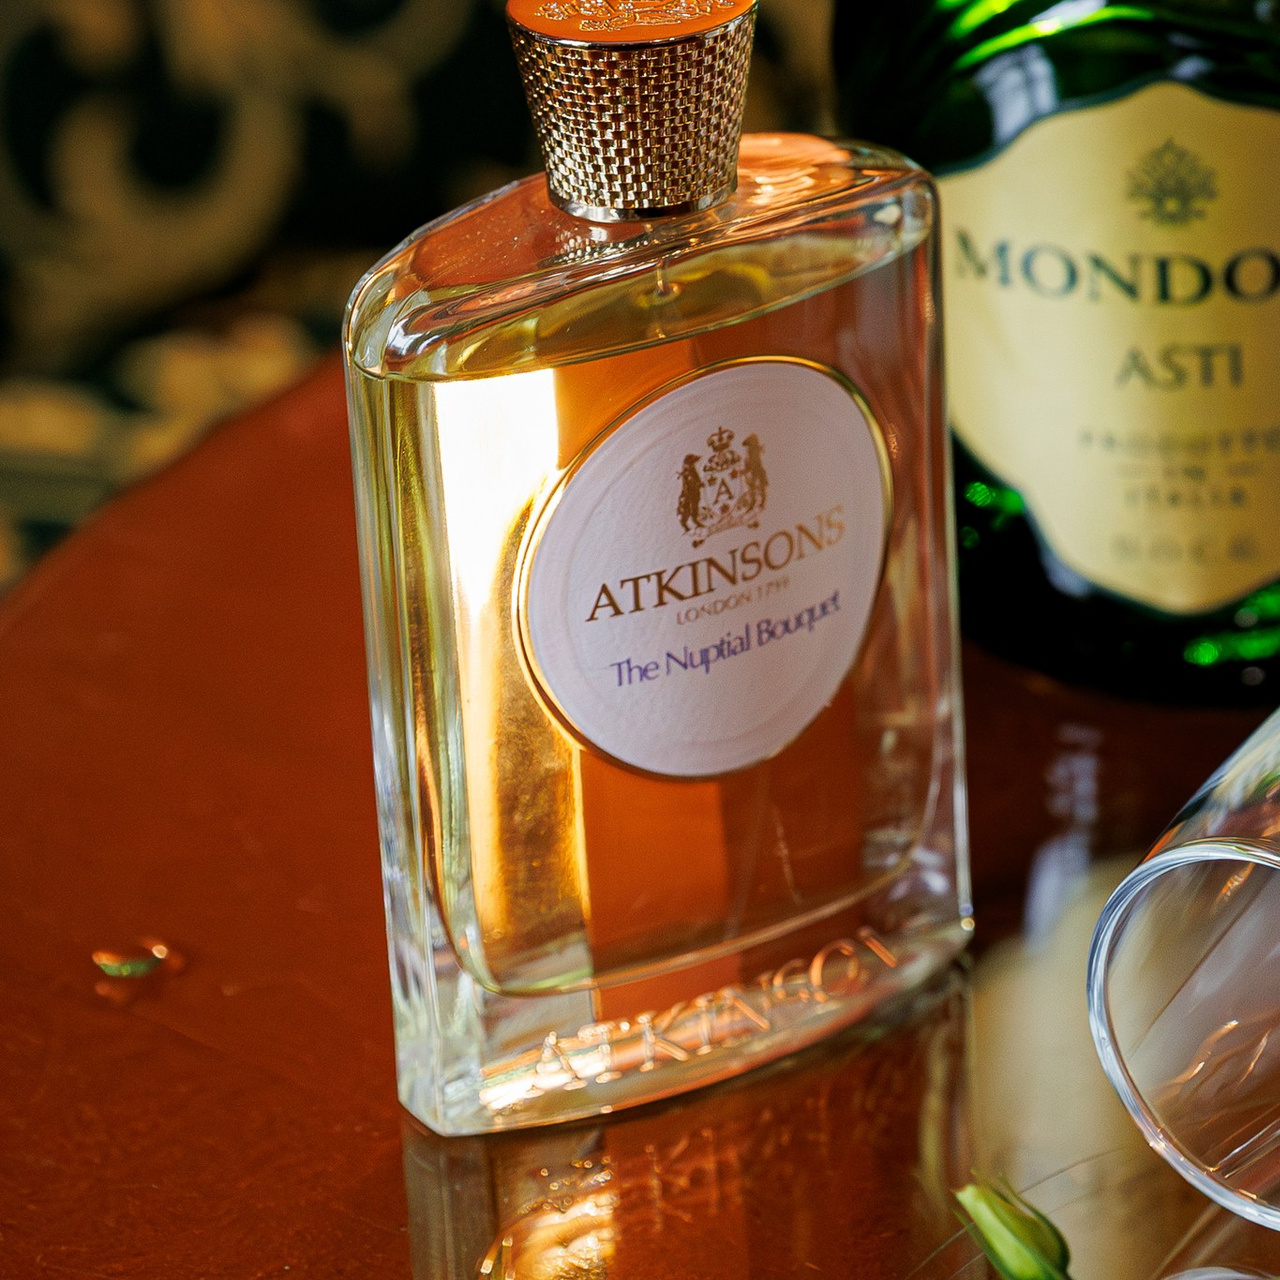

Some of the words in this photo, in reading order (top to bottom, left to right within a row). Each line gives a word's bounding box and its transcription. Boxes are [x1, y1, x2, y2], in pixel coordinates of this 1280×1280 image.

[1116, 342, 1246, 390] ASTI
[713, 478, 734, 505] A
[585, 505, 845, 622] ATKINSONS
[676, 592, 752, 625] LONDON
[610, 657, 660, 688] The
[665, 622, 751, 676] Nuptial
[756, 588, 840, 648] Bouquet
